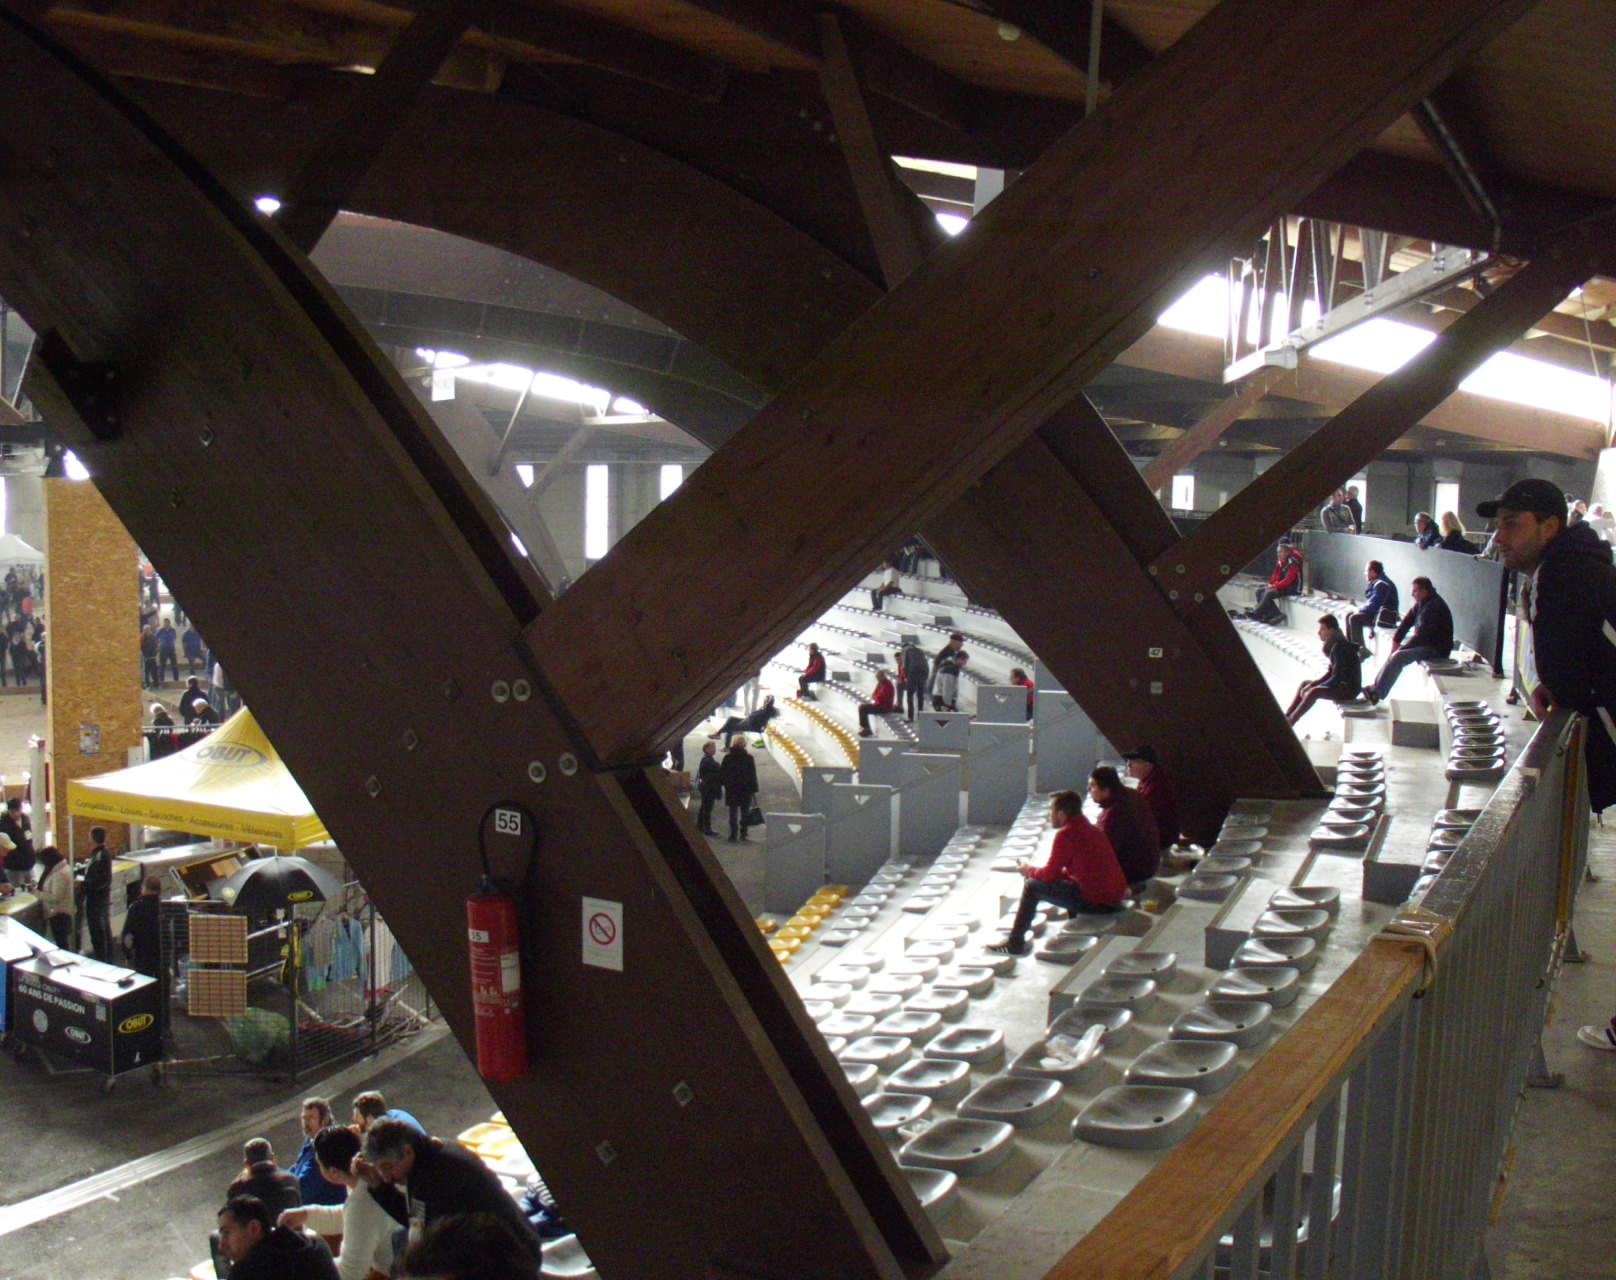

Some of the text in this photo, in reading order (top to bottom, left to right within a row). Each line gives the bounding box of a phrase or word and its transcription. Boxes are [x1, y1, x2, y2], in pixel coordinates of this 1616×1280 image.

[196, 746, 251, 763] OBUT
[496, 812, 519, 832] 55
[54, 995, 86, 1016] PASSION
